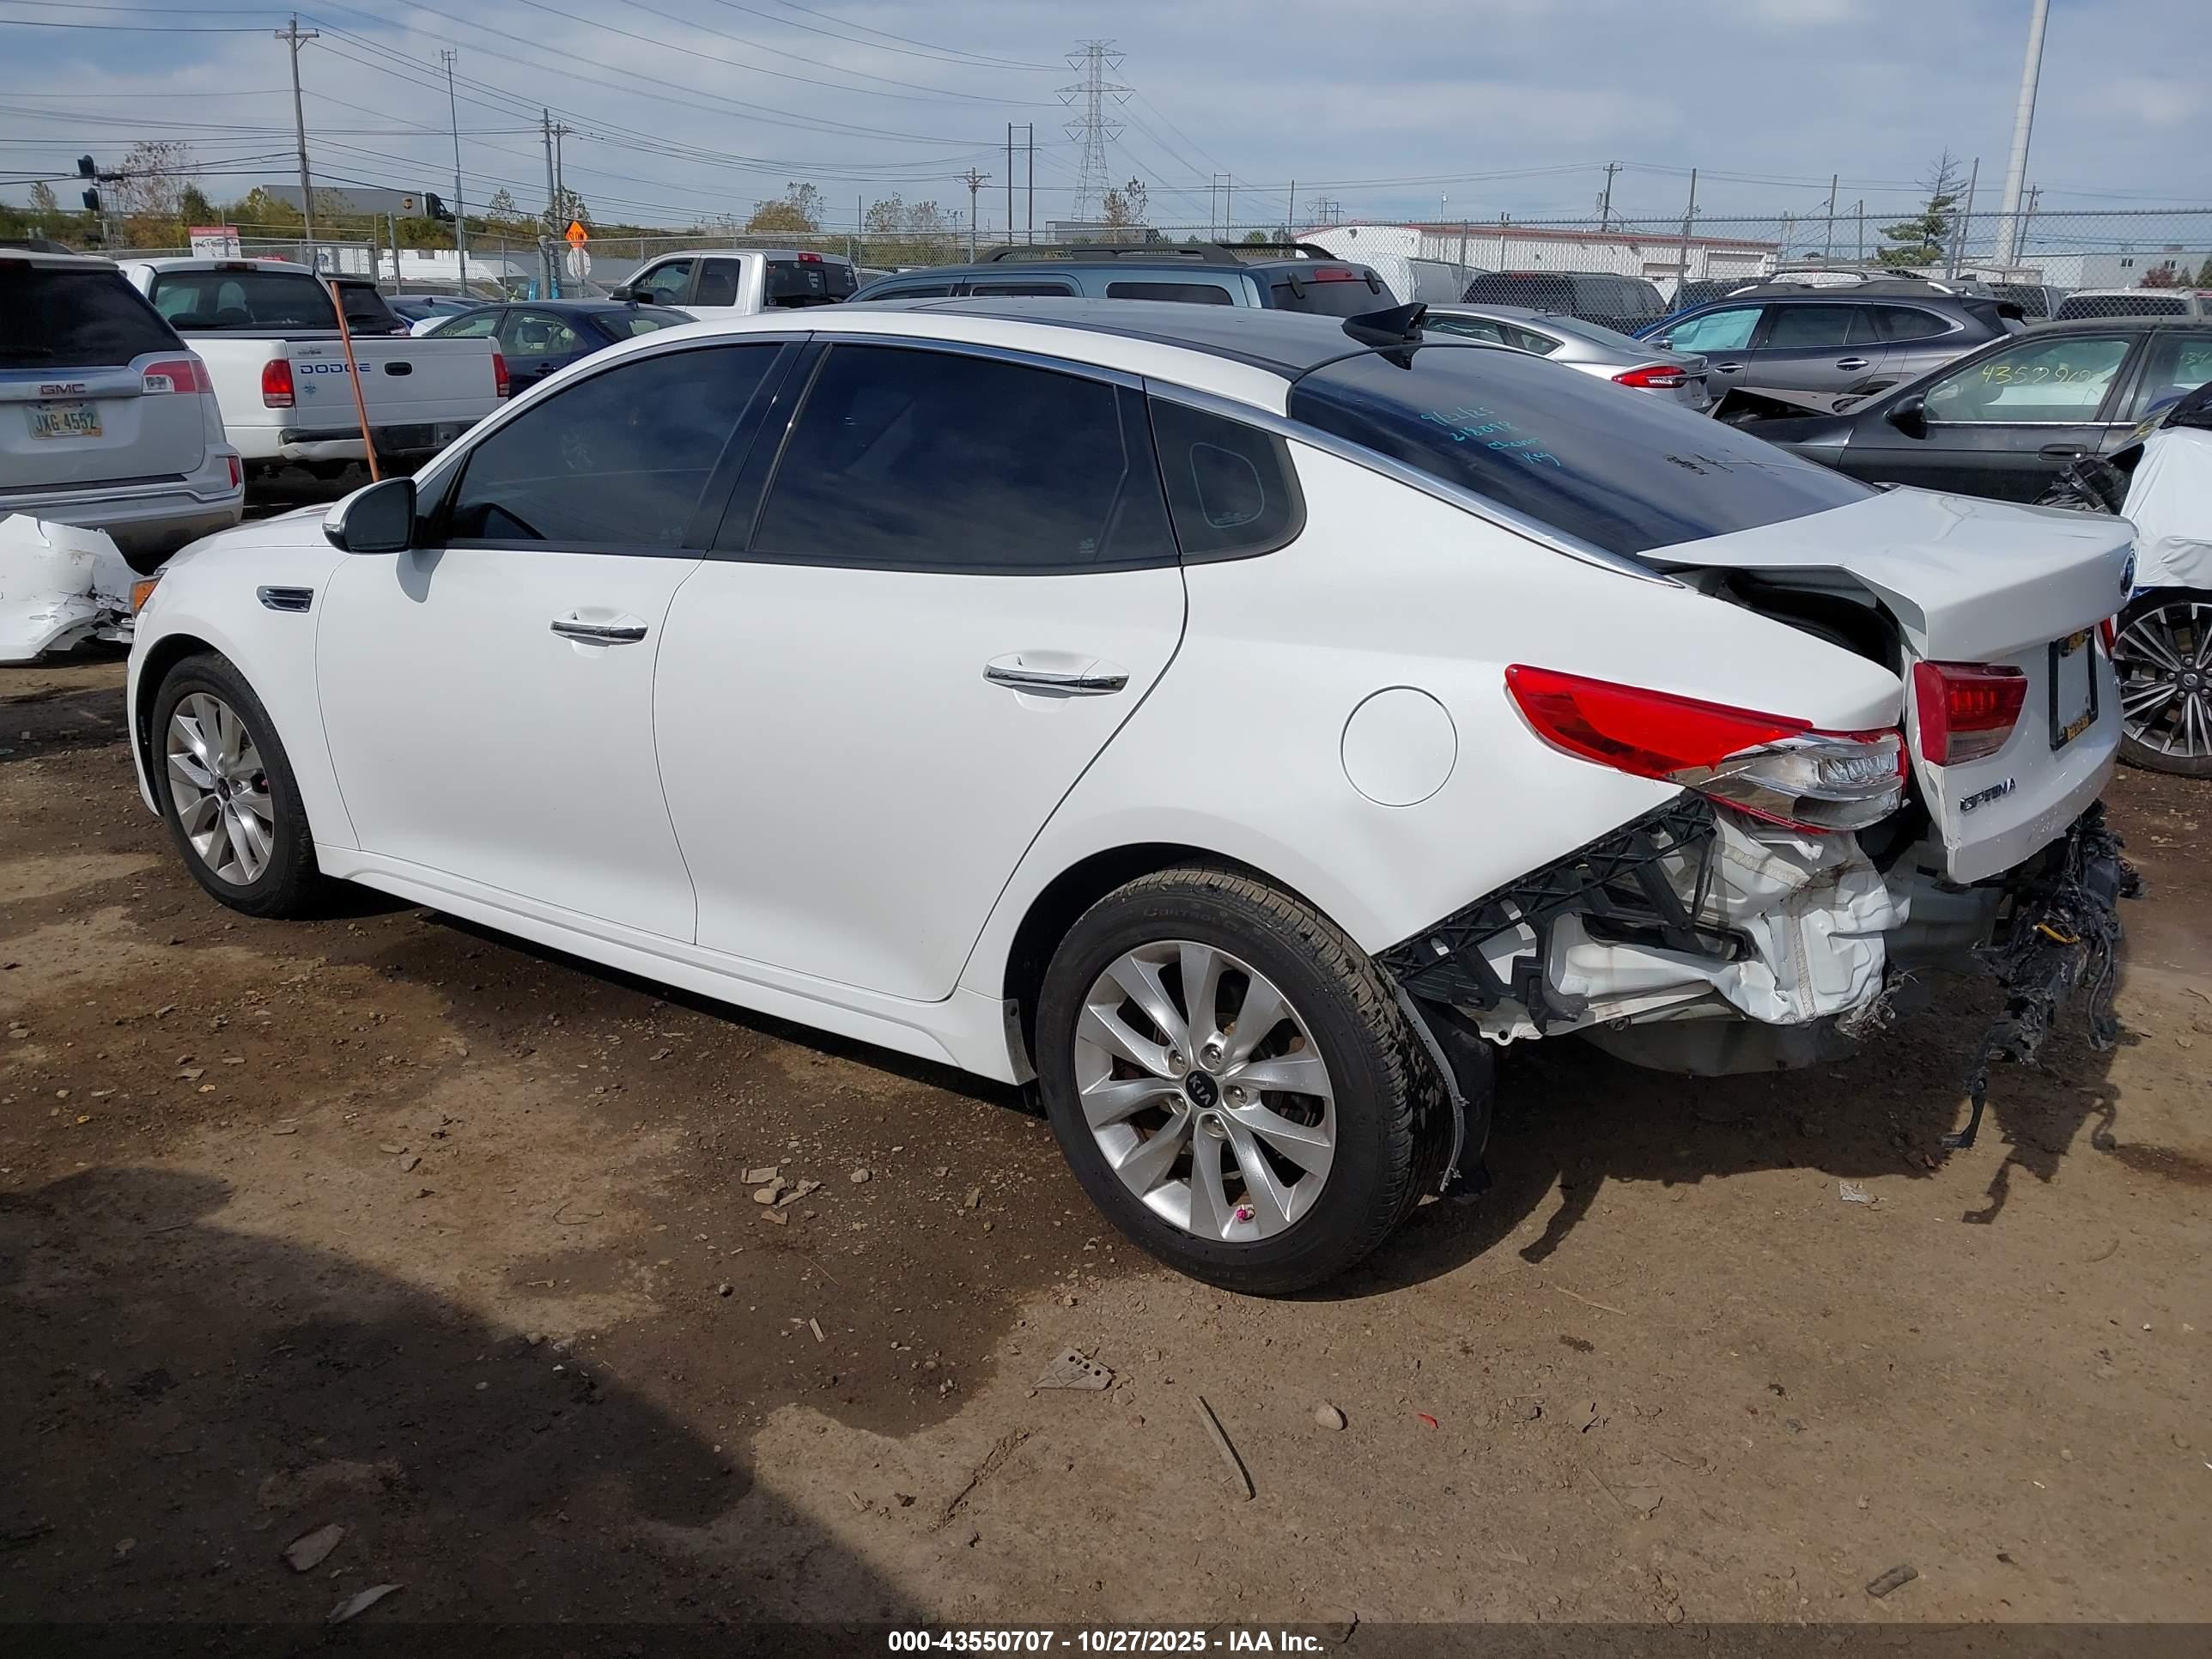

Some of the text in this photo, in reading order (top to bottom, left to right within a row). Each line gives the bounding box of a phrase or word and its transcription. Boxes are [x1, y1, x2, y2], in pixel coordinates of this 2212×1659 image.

[40, 383, 87, 395] GMC
[36, 412, 97, 432] JXG 4552
[1188, 1074, 1212, 1106] KIA
